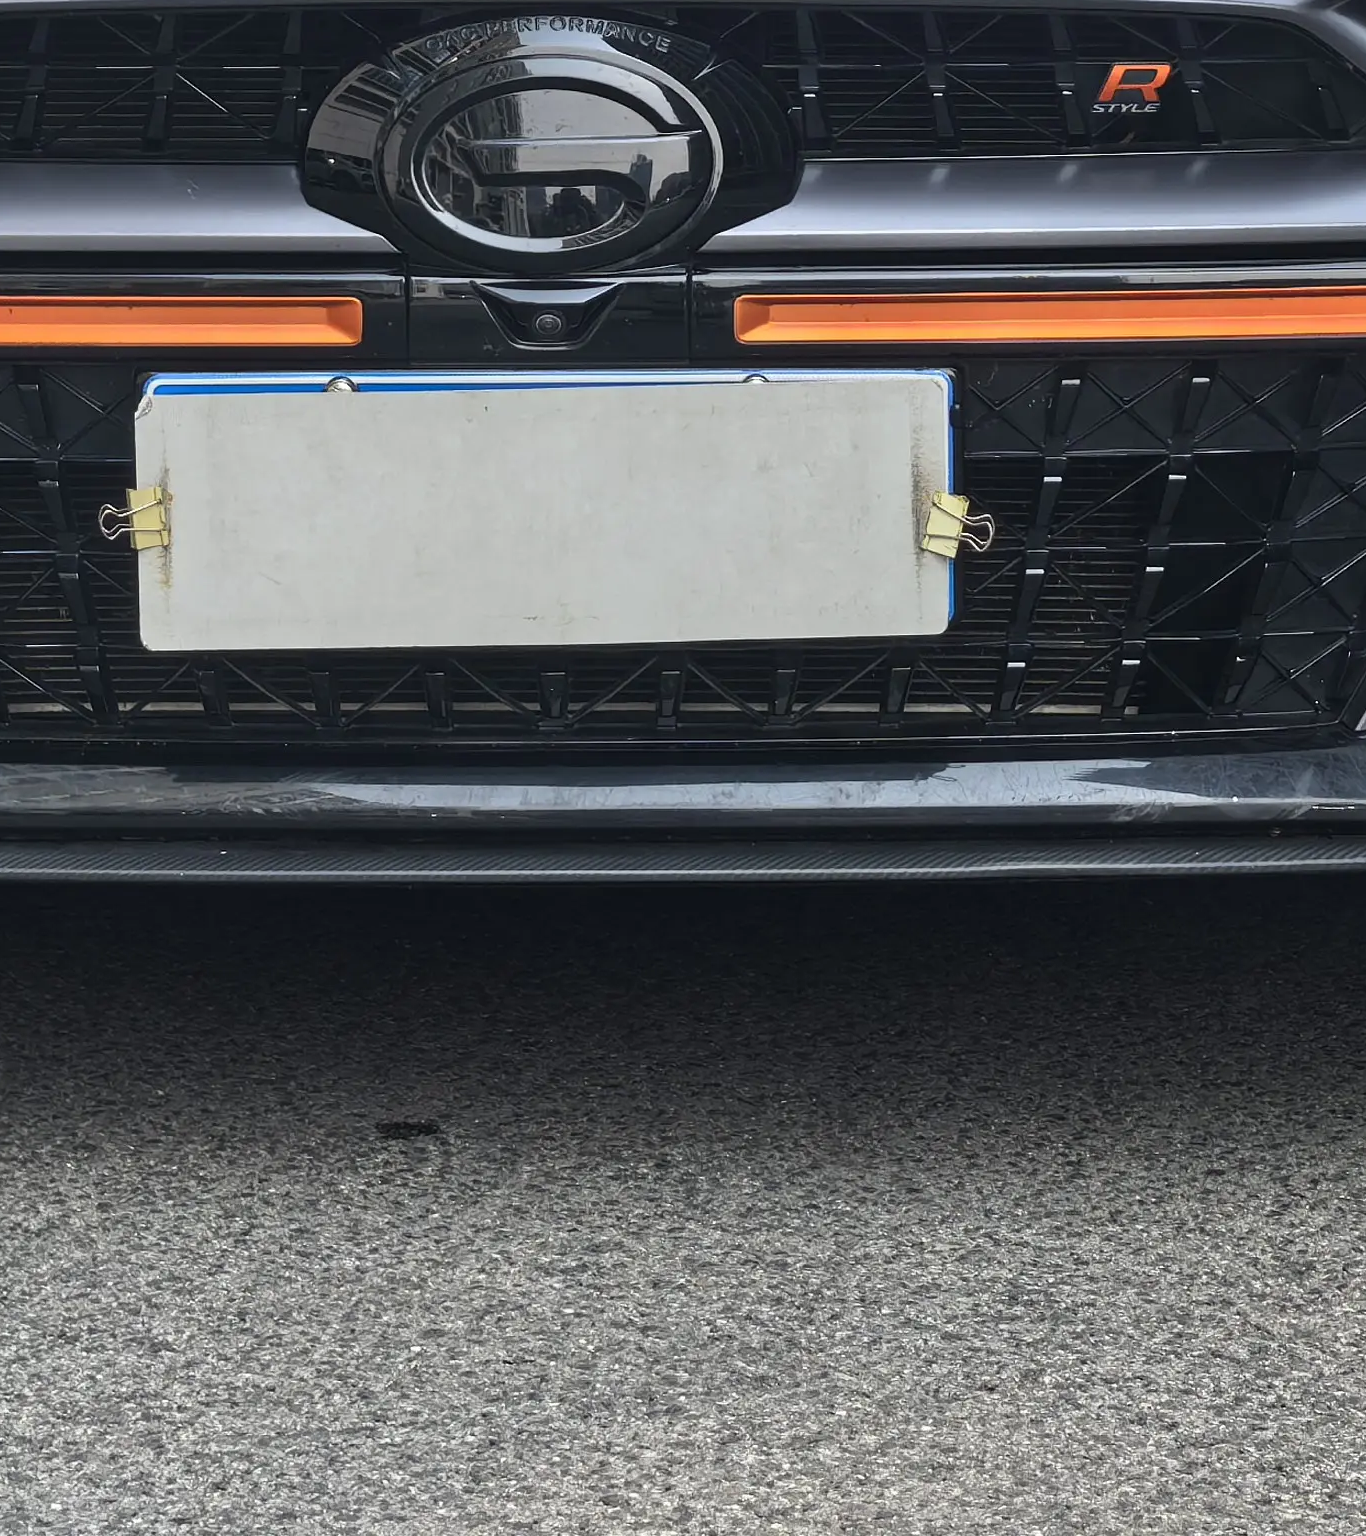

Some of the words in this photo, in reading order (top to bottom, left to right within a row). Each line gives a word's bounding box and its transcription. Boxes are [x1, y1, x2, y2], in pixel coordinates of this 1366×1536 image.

[485, 15, 671, 53] PERFORMANCE
[1097, 63, 1171, 102] R
[1091, 102, 1161, 113] STYLE
